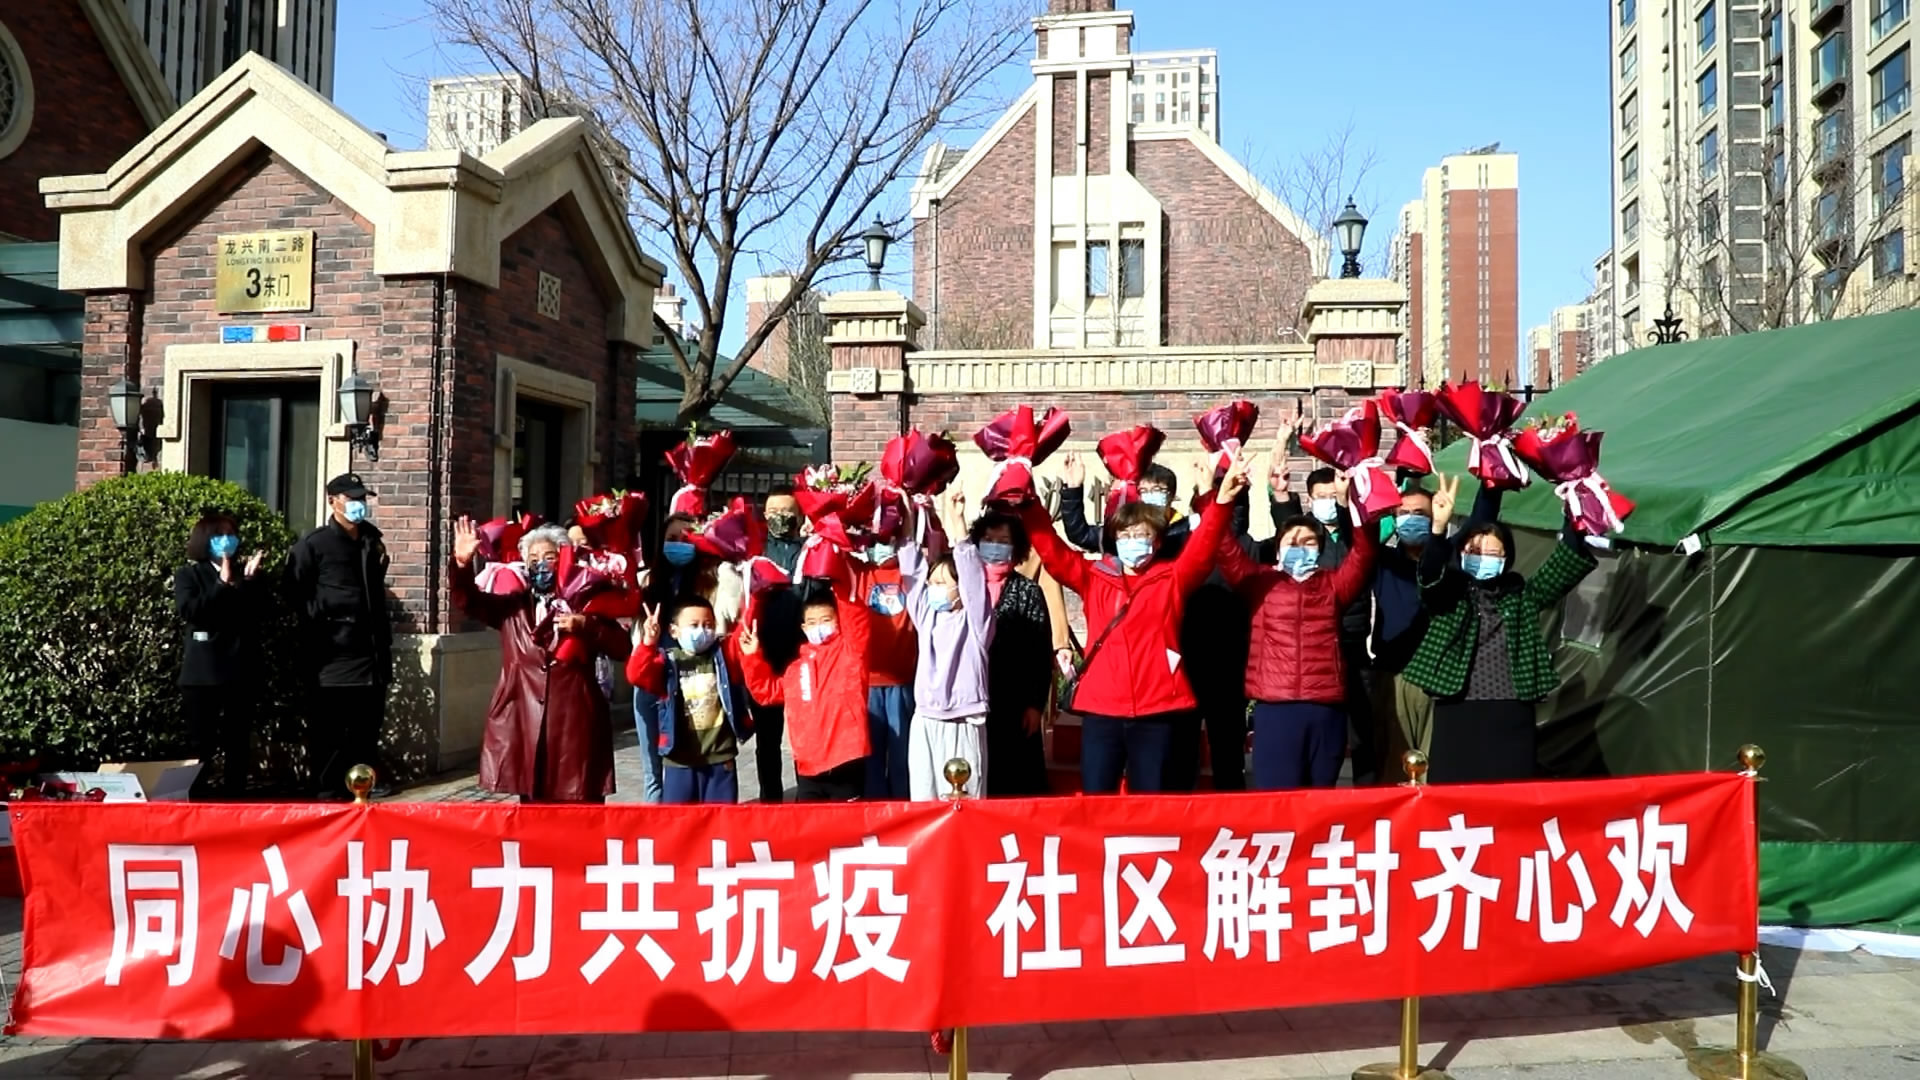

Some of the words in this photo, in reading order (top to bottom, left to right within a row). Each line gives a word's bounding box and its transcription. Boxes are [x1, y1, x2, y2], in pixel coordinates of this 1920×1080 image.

[225, 237, 304, 255] 龙兴南二路
[226, 256, 262, 266] LONGXING
[104, 836, 911, 991] 同心协力共抗疫
[985, 804, 1695, 979] 社区解封齐心欢
